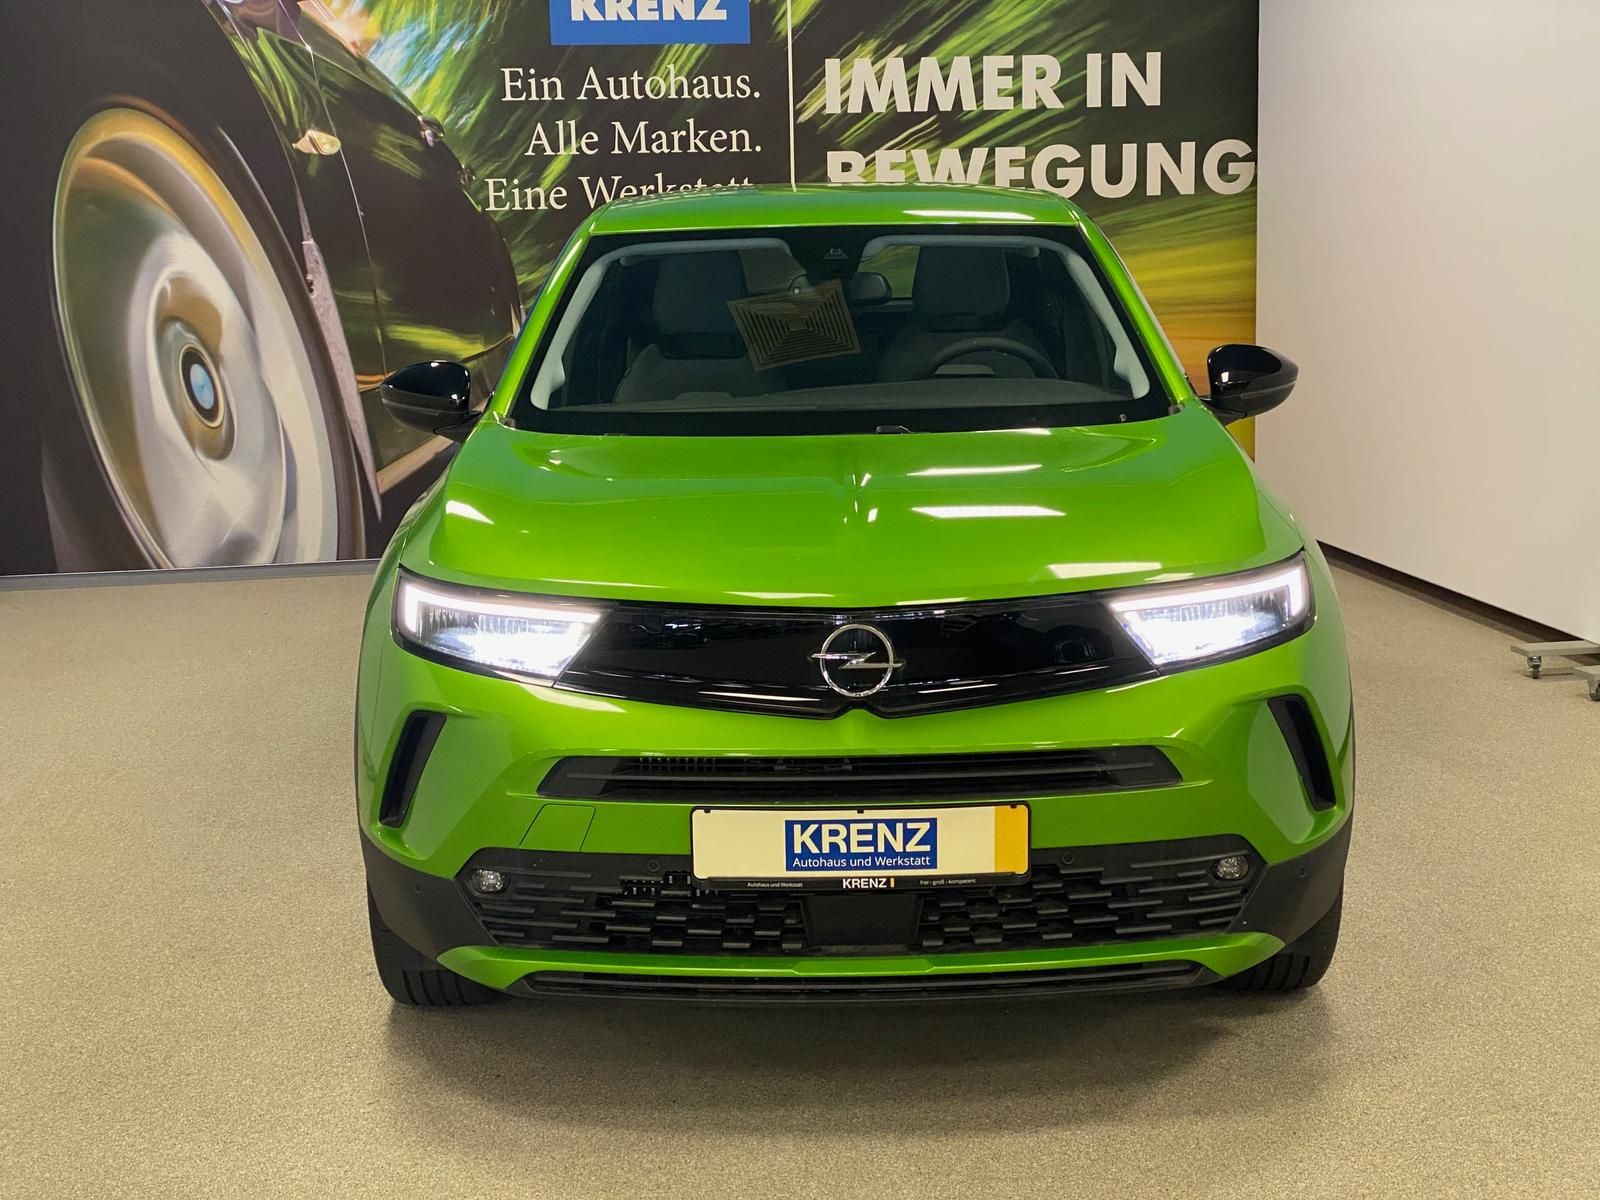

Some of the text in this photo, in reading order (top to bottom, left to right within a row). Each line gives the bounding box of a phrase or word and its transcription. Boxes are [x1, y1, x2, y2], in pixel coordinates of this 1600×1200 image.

[571, 0, 728, 21] KRENZ
[500, 64, 761, 101] Ein Autohaus.
[824, 51, 1162, 114] IMMER IN
[524, 118, 762, 156] Alle Marken.
[827, 139, 1256, 199] BEWEGUNG
[484, 177, 568, 211] Eine
[793, 822, 931, 854] KRENZ
[792, 855, 930, 868] Autohaus und Werkstatt
[842, 878, 888, 889] KRENZ
